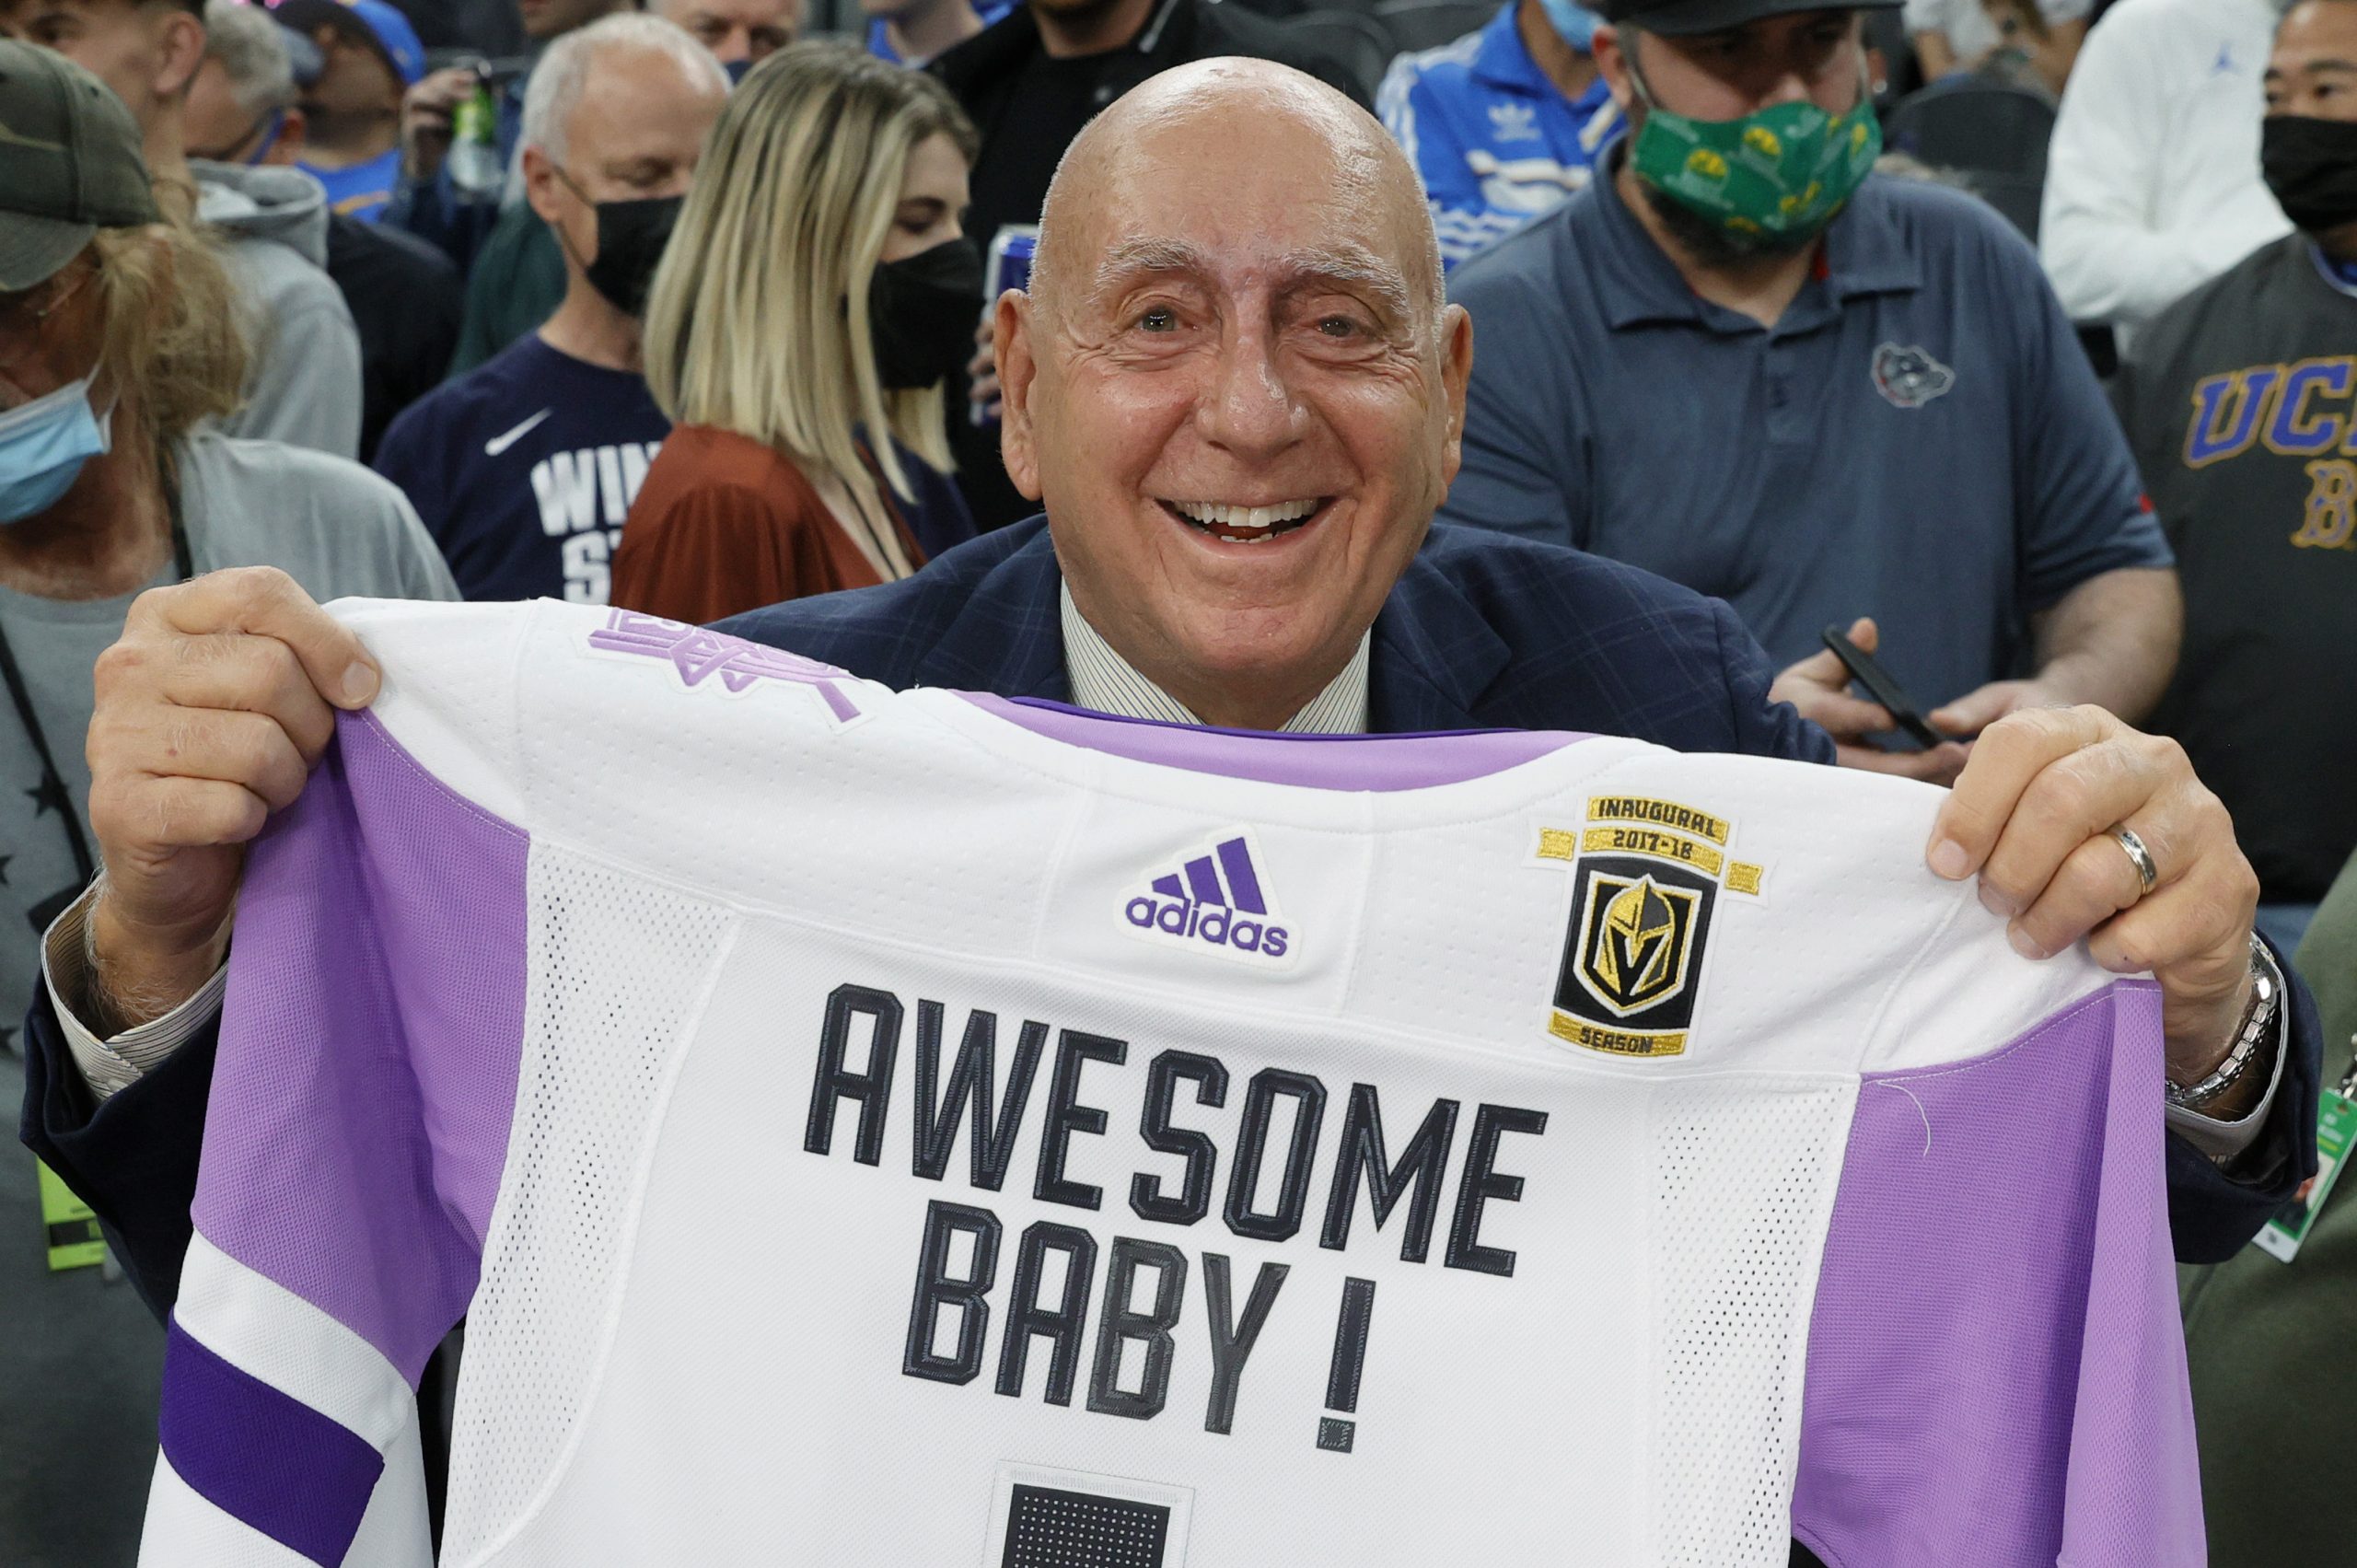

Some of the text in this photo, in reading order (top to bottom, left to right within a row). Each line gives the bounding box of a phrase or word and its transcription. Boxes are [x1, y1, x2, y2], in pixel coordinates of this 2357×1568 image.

[2182, 355, 2357, 470] UC
[2290, 459, 2357, 550] B
[562, 529, 622, 606] S
[1597, 798, 1716, 839] INAUGURAL
[1612, 829, 1693, 860] 2017-18
[1125, 893, 1288, 957] adidas
[1579, 1025, 1654, 1053] SEASON
[803, 982, 1550, 1278] AWESOME
